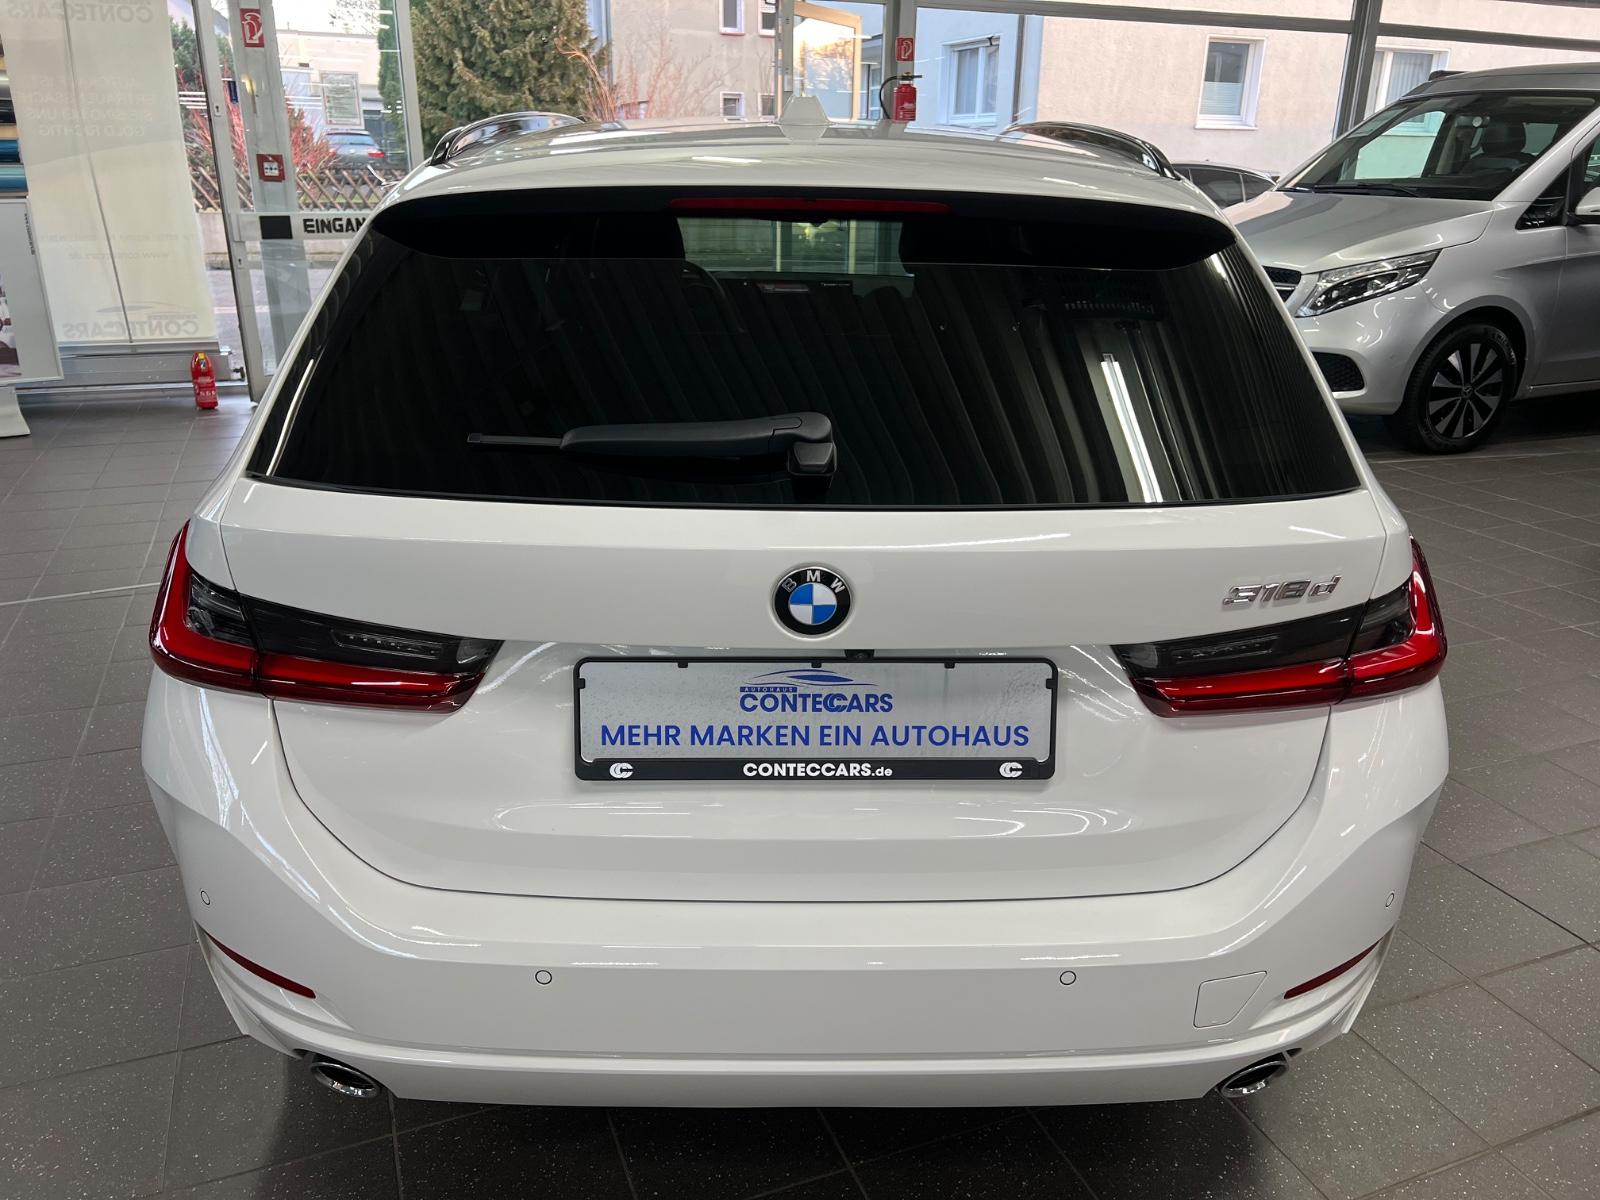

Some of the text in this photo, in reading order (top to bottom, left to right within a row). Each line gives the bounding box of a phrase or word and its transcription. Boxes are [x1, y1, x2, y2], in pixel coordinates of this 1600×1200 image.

[781, 569, 846, 593] BMW
[1222, 575, 1342, 605] 318d
[601, 725, 1029, 747] MEHR MARKEN EIN AUTOHAUS
[743, 762, 893, 777] CONTECCARS.de
